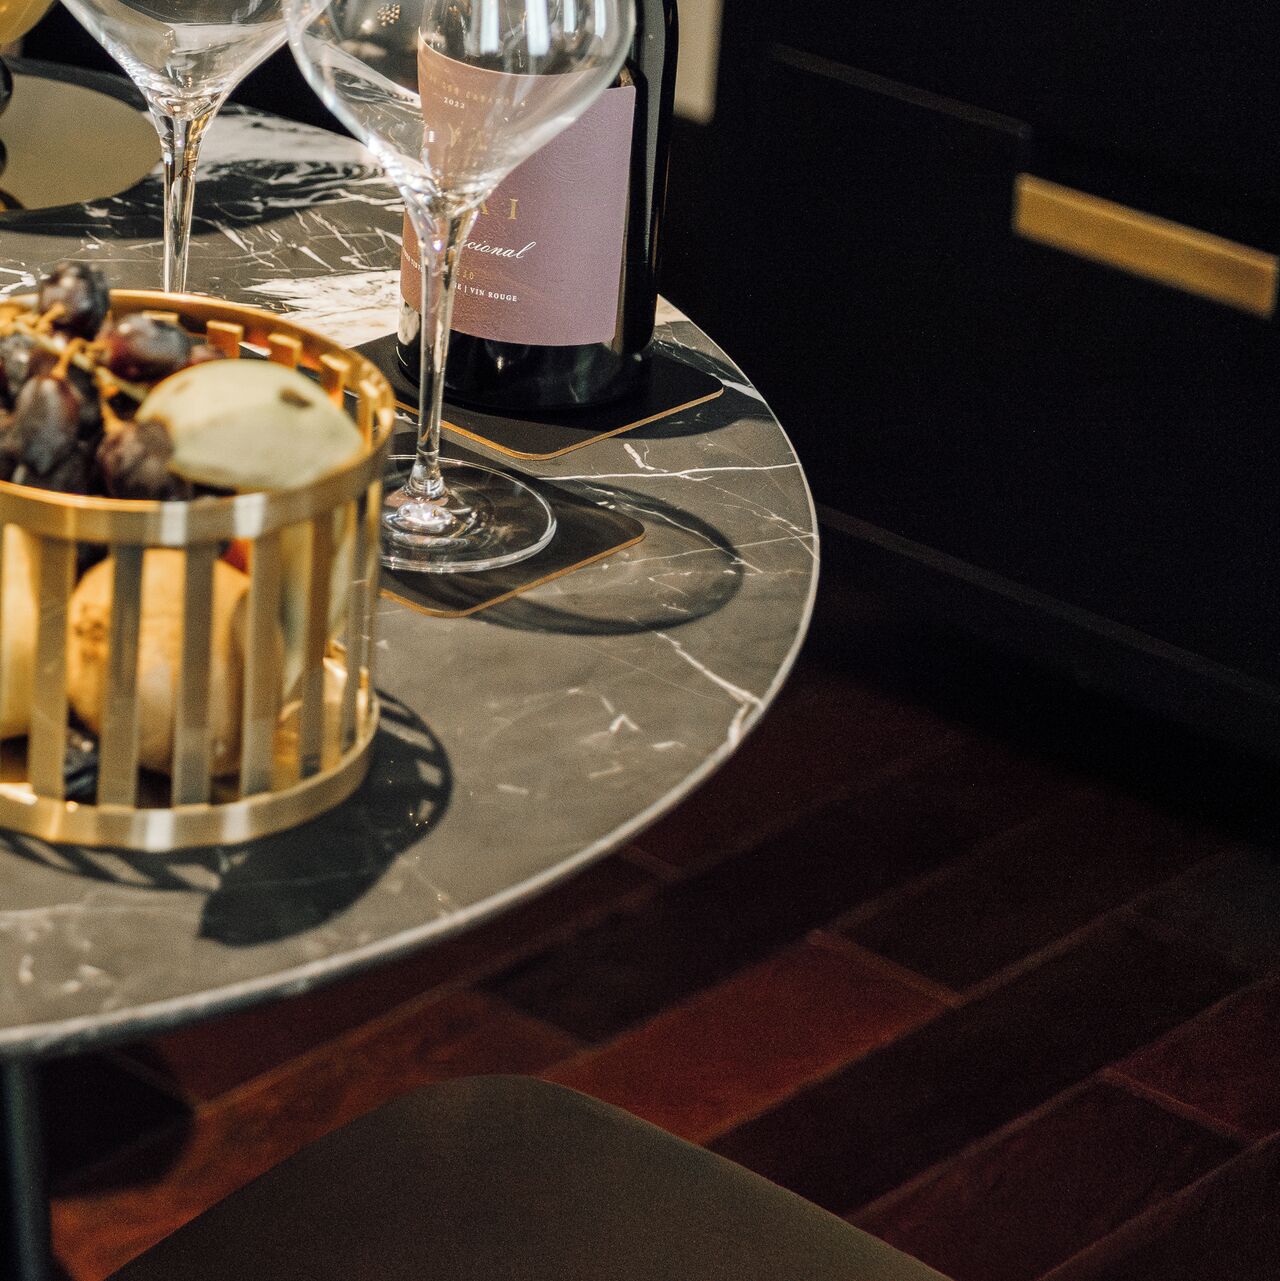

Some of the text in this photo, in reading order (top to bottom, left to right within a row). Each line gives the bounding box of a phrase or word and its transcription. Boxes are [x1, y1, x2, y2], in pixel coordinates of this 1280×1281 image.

[443, 97, 465, 109] 2022
[463, 240, 536, 259] cional
[470, 287, 518, 302] VIN ROUGE
